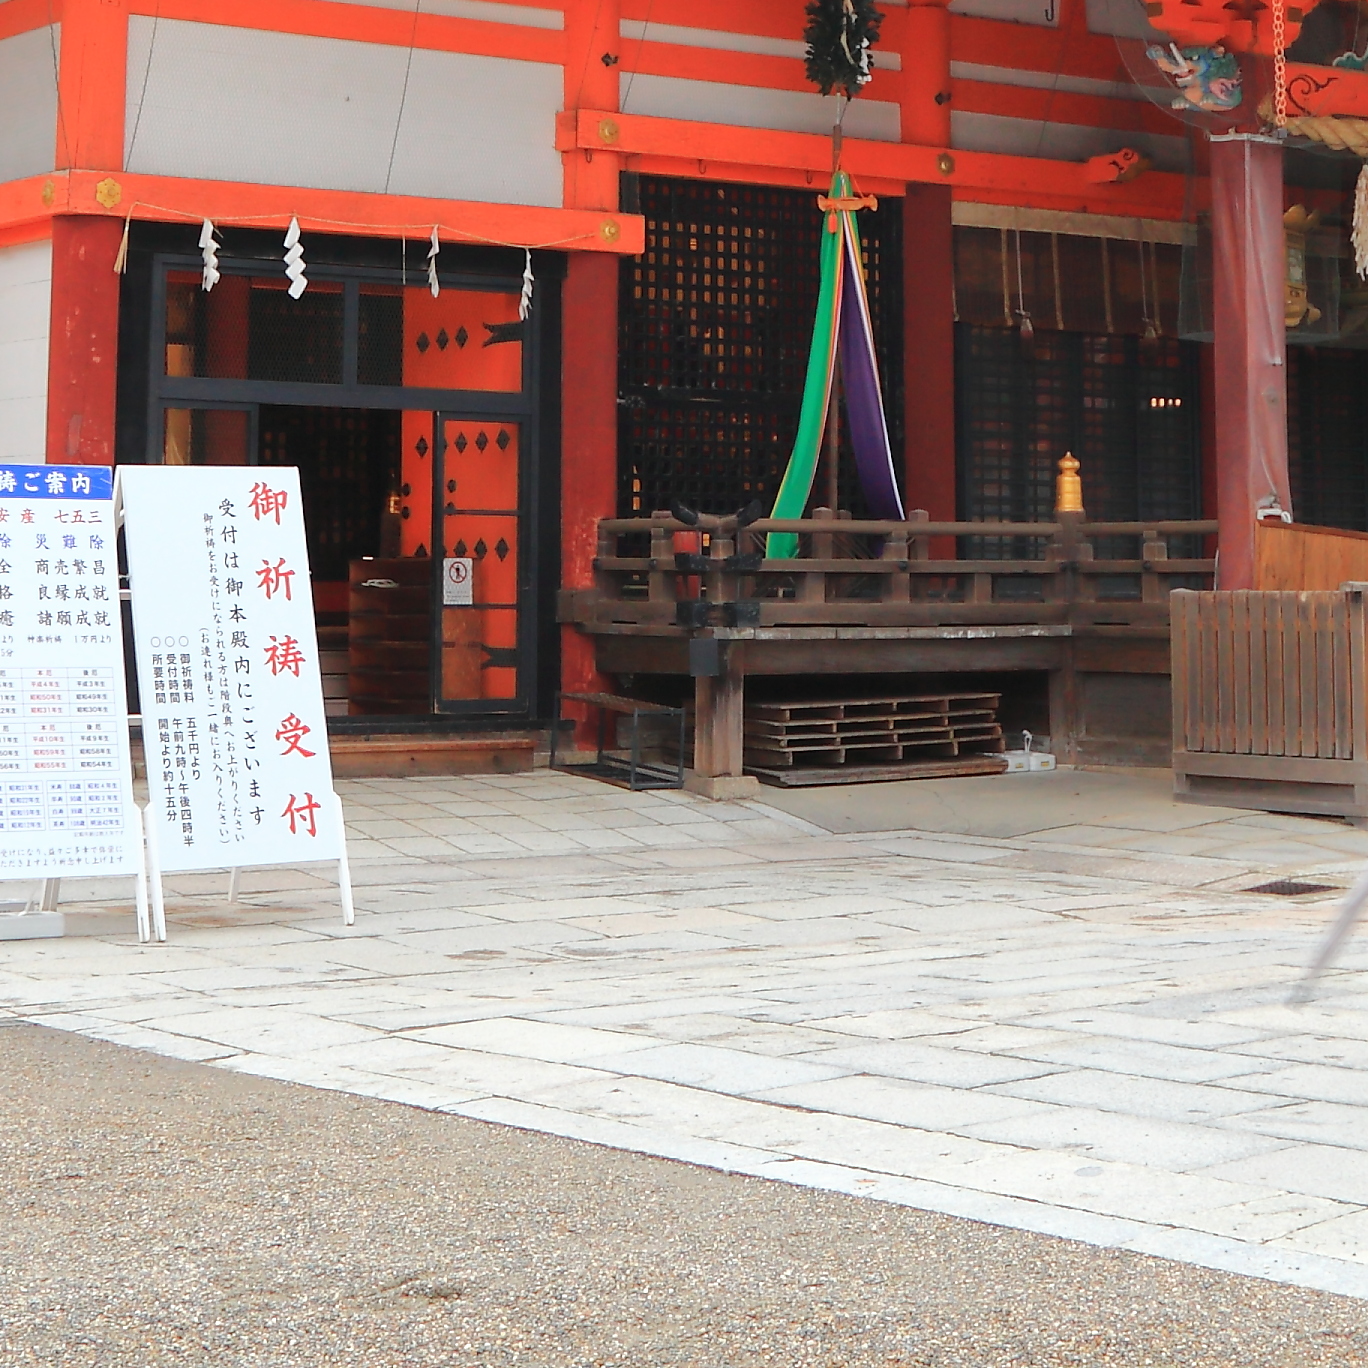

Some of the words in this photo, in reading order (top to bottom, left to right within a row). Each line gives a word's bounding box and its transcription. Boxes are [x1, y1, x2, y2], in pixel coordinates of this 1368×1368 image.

[54, 509, 103, 524] 七五三
[35, 533, 104, 550] 災難除
[35, 559, 105, 575] 商売繁昌
[38, 584, 109, 601] 良縁成就
[37, 610, 111, 626] 諸願成就
[152, 654, 166, 704] 所要時間
[166, 654, 180, 704] 受付時間
[180, 654, 194, 703] 御祈祷料
[218, 498, 264, 826] 受付は御本殿内にございます
[248, 482, 321, 837] 御祈祷受付
[158, 718, 178, 822] 開始より約十五分
[186, 717, 200, 780] 五千円より
